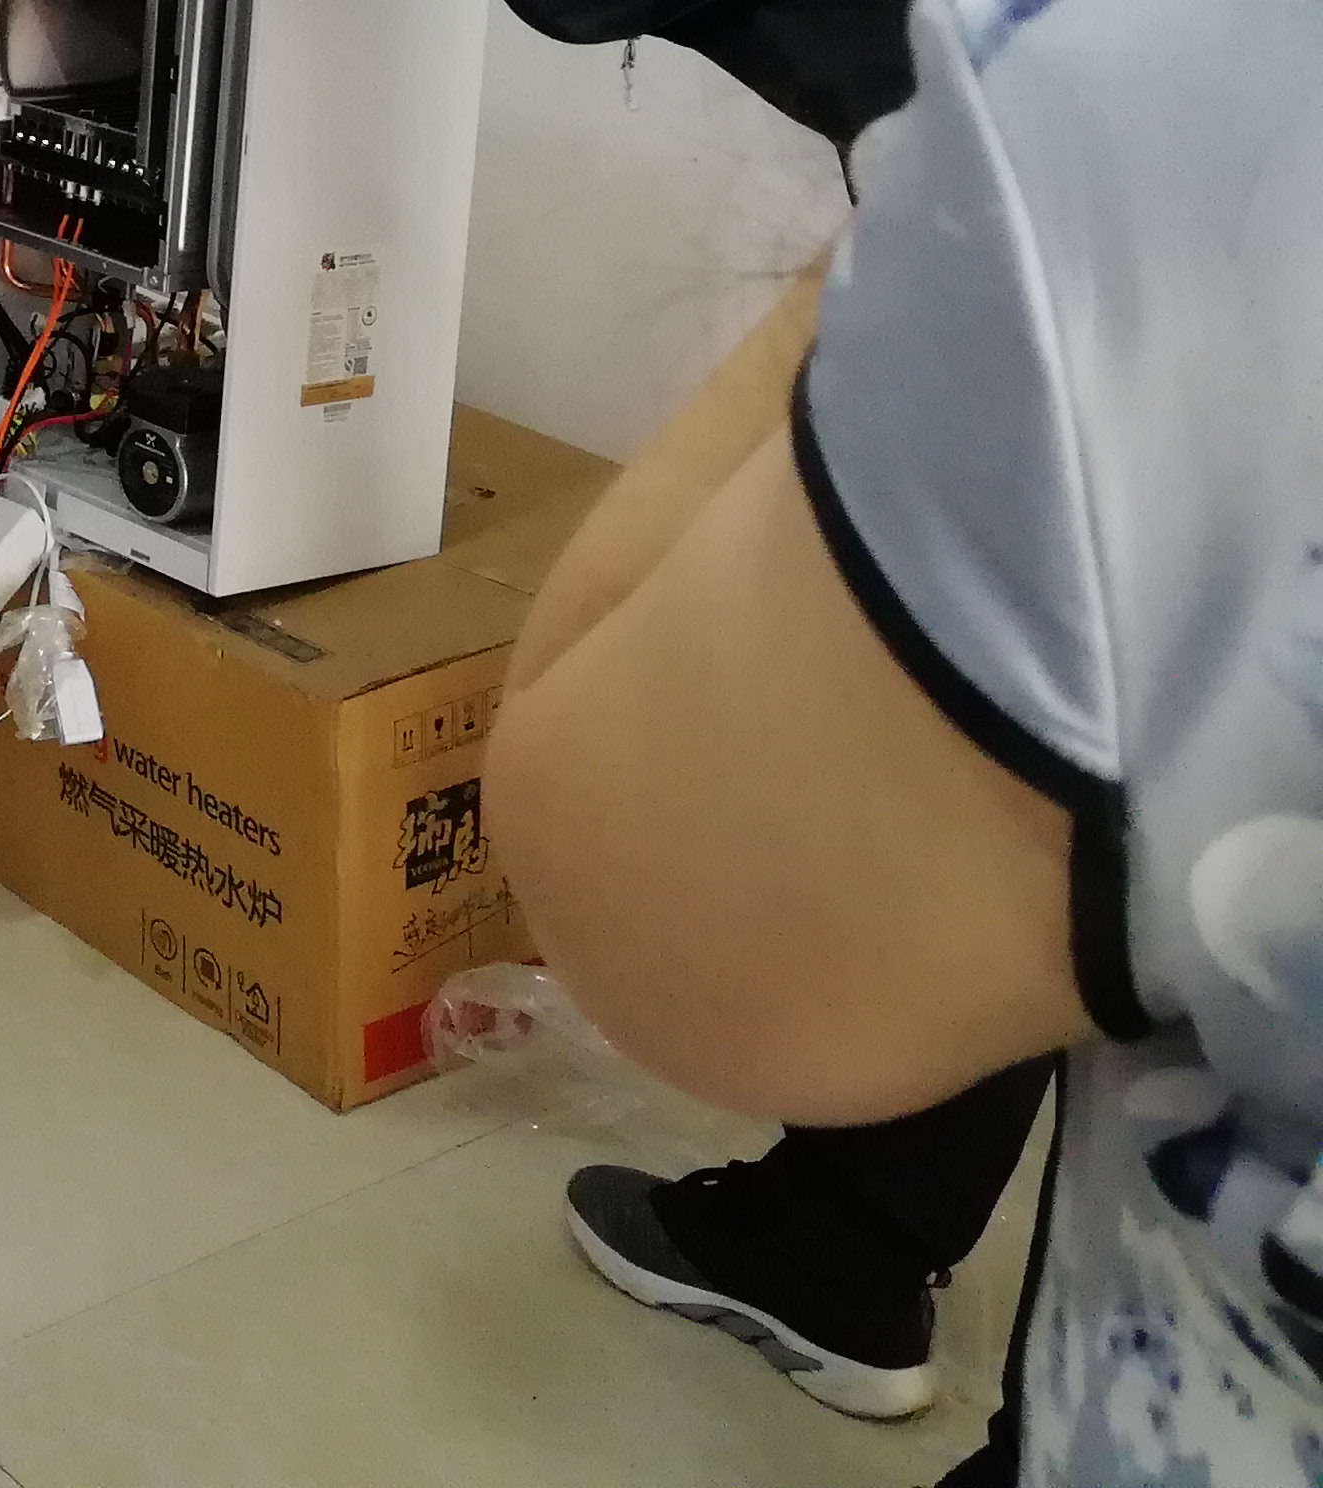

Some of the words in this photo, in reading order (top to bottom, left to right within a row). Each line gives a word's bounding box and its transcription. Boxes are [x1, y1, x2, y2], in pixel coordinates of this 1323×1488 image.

[59, 762, 283, 928] 燃气采暖热水炉
[113, 736, 181, 796] water
[186, 771, 282, 856] heaters
